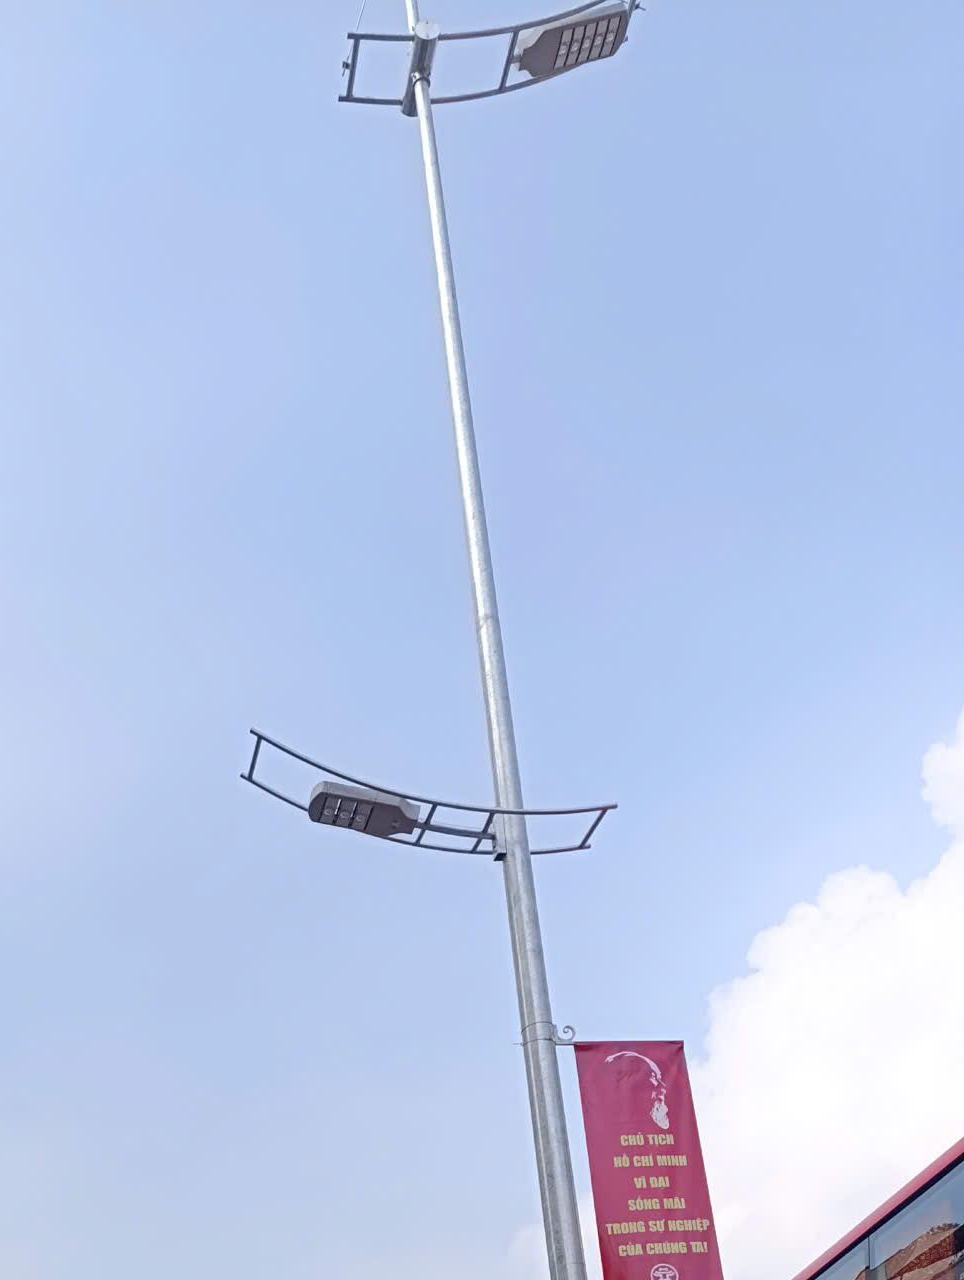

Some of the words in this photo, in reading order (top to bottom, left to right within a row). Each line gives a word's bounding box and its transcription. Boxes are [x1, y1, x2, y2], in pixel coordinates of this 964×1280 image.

[620, 1131, 644, 1146] CHỦ
[646, 1134, 675, 1147] TỊCH
[613, 1152, 630, 1168] HỒ
[633, 1153, 654, 1167] CHÍ
[656, 1155, 687, 1167] MINH
[649, 1176, 670, 1189] ĐẠI
[628, 1195, 660, 1211] SỐNG
[663, 1196, 686, 1209] MÃI
[605, 1221, 646, 1235] TRONG
[648, 1219, 665, 1233] SỰ
[668, 1218, 710, 1232] NGHIỆP
[618, 1242, 644, 1257] CỦA
[646, 1241, 687, 1255] CHÚNG
[690, 1241, 708, 1253] TA!
